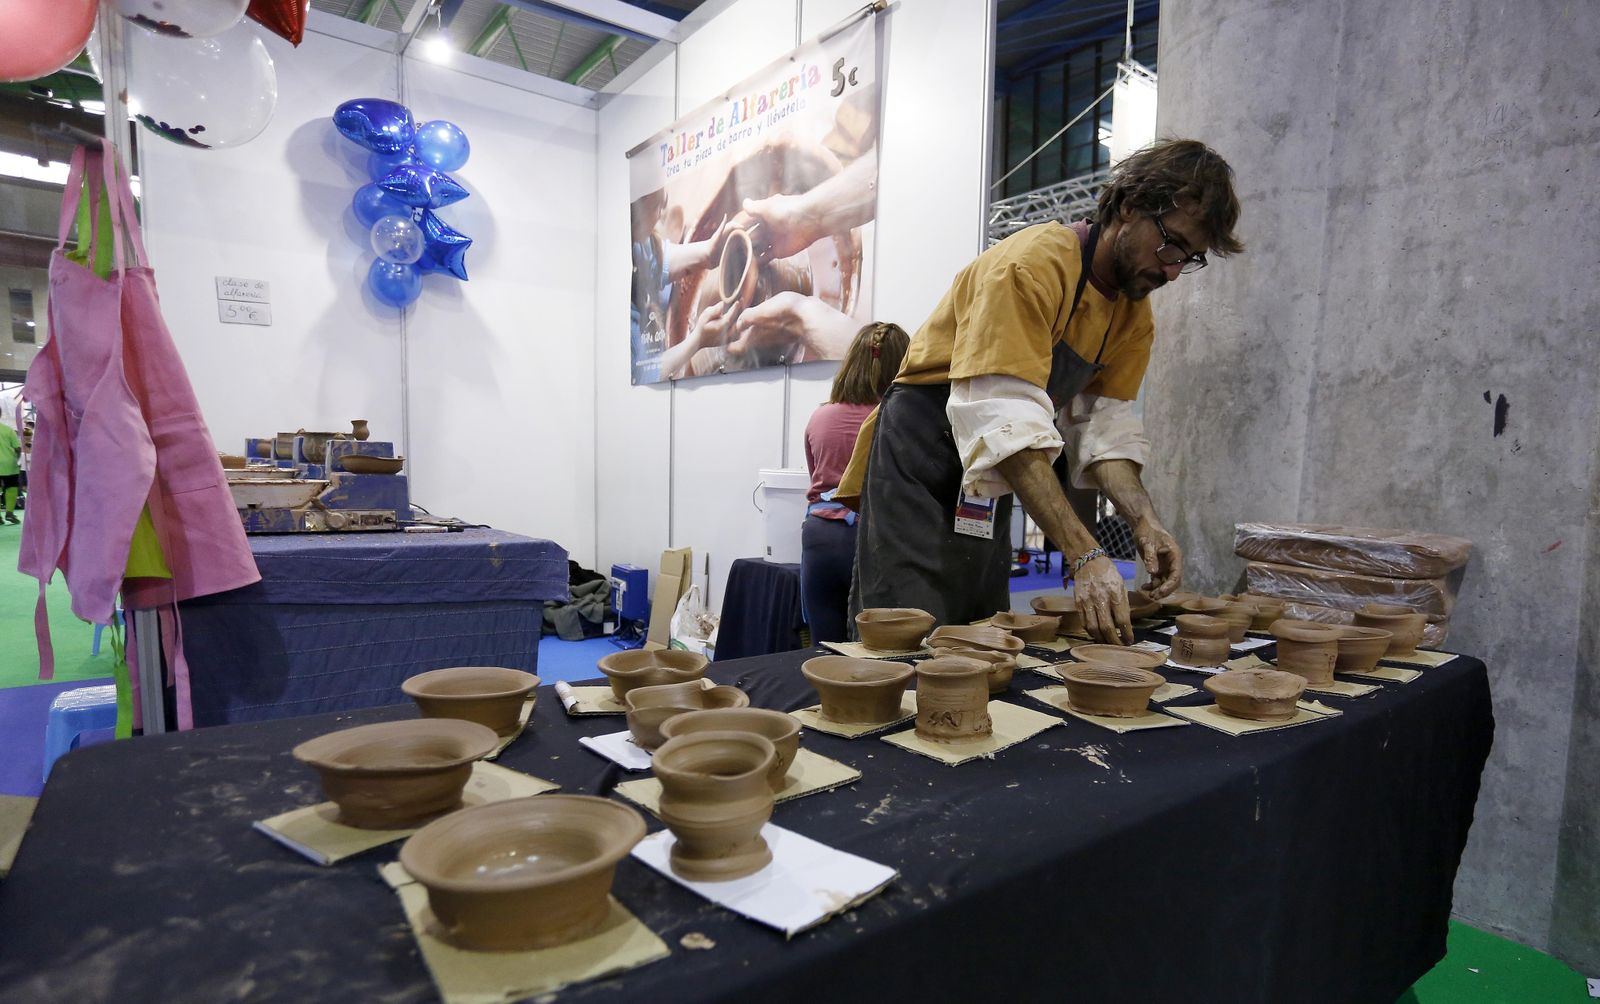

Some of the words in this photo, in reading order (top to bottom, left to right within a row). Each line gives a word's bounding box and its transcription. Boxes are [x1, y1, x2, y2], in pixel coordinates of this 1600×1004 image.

[660, 131, 703, 168] Taller
[708, 116, 725, 139] de
[728, 63, 822, 128] Alfarería
[683, 158, 692, 168] tu
[694, 146, 712, 167] pieza
[716, 138, 727, 152] de
[756, 120, 763, 135] y
